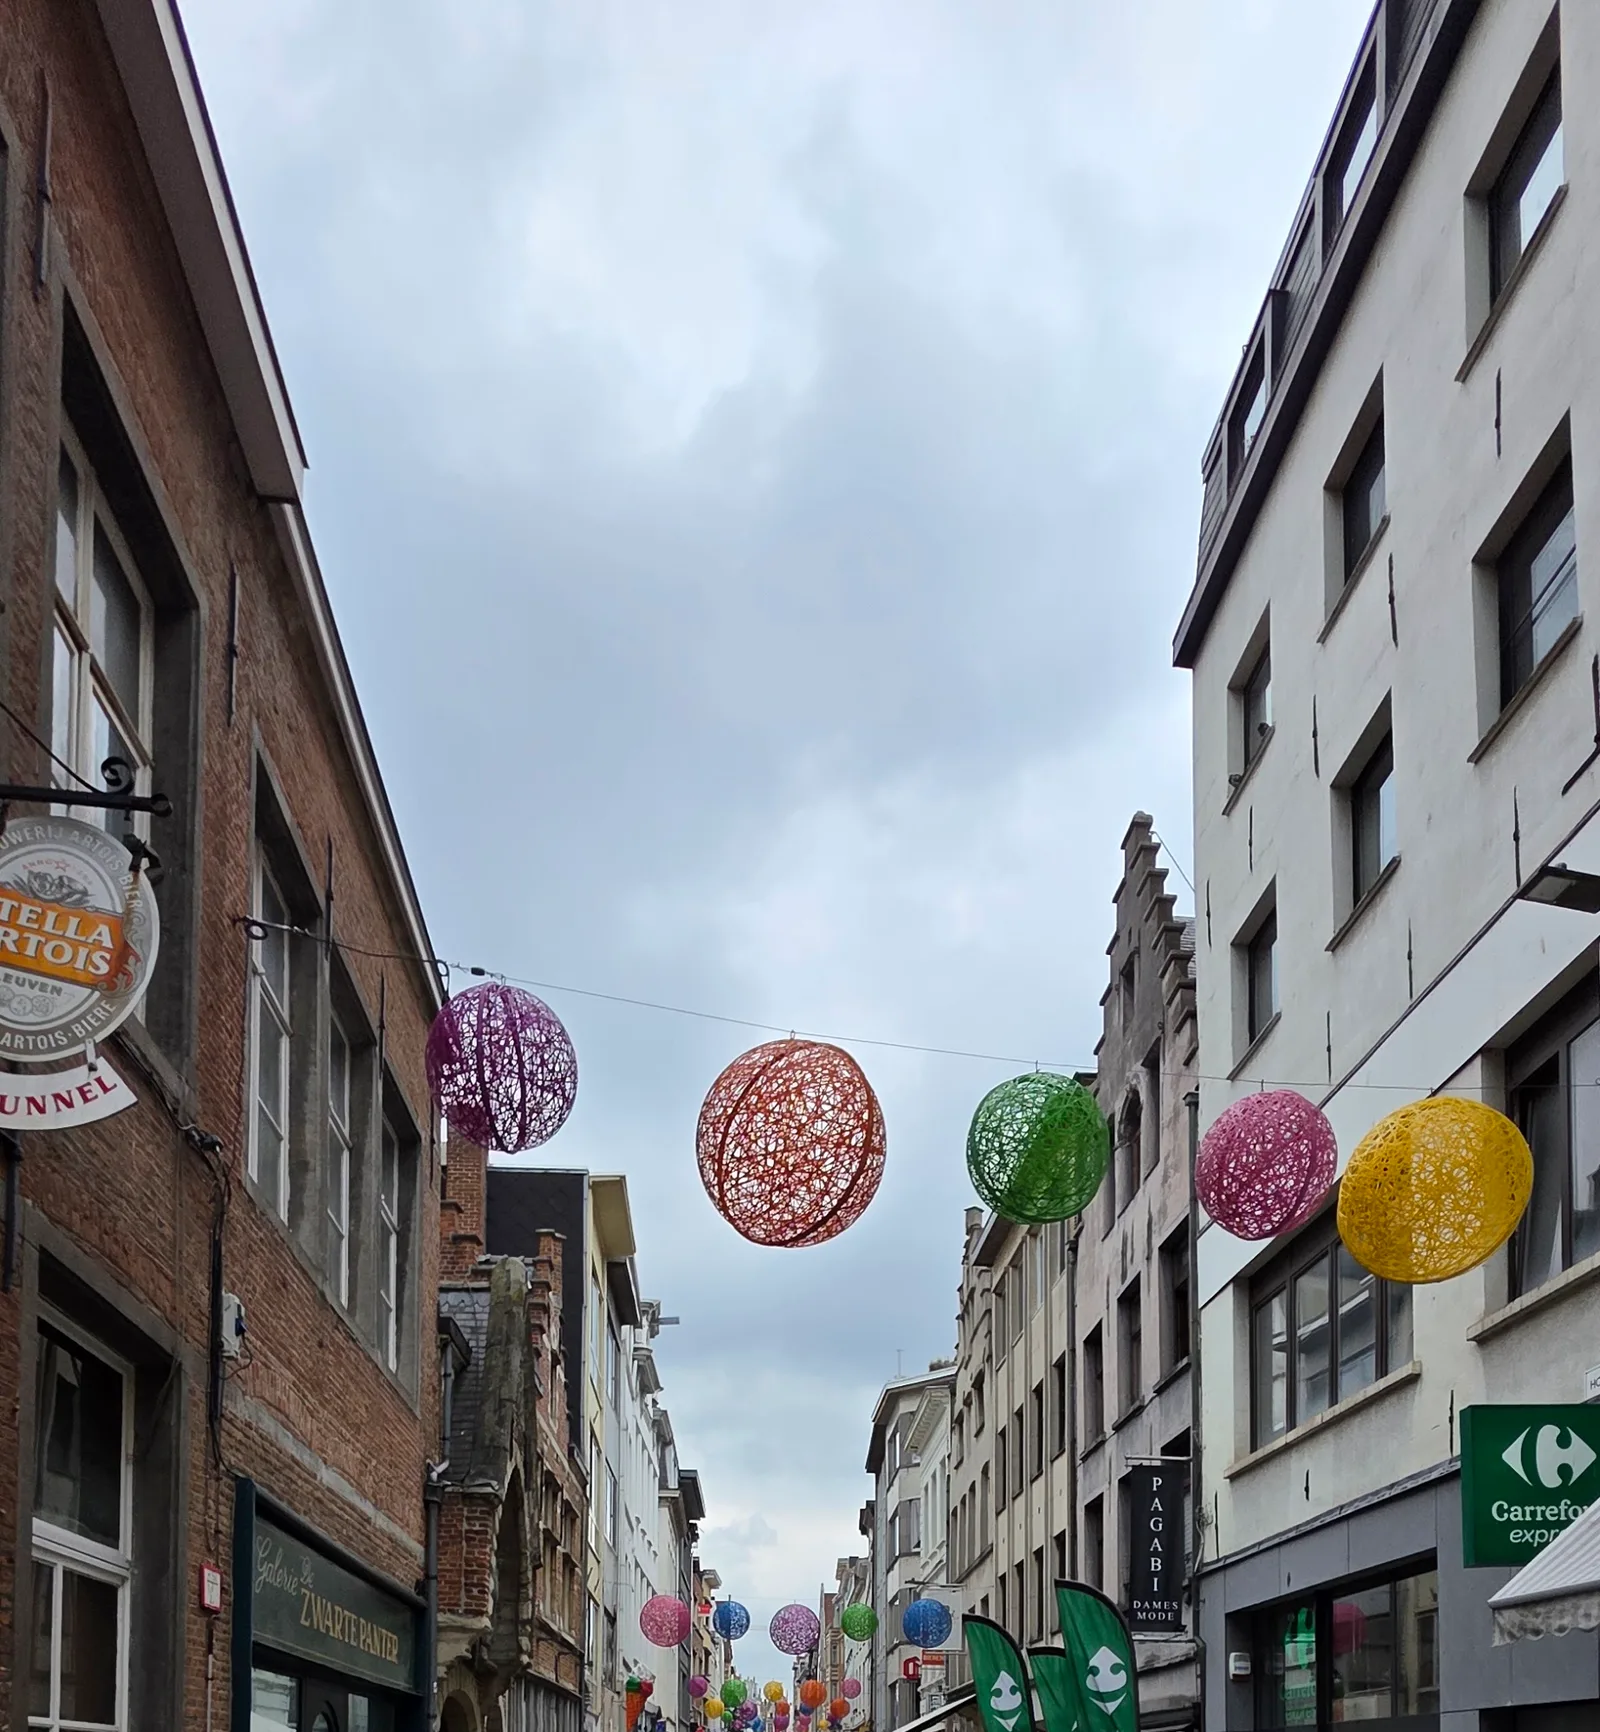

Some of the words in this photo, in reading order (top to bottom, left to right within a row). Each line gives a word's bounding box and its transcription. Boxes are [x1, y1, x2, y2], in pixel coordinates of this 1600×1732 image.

[69, 830, 123, 871] ARTOIS
[119, 874, 142, 908] BIER
[0, 973, 62, 996] EUVEN
[1149, 1476, 1164, 1592] PAGABI
[1509, 1528, 1560, 1547] expr
[255, 1533, 299, 1597] Galerie
[300, 1588, 359, 1648] ZWARTE
[359, 1616, 399, 1665] PANTER
[1133, 1601, 1179, 1610] DAMES
[1137, 1612, 1175, 1621] MODE
